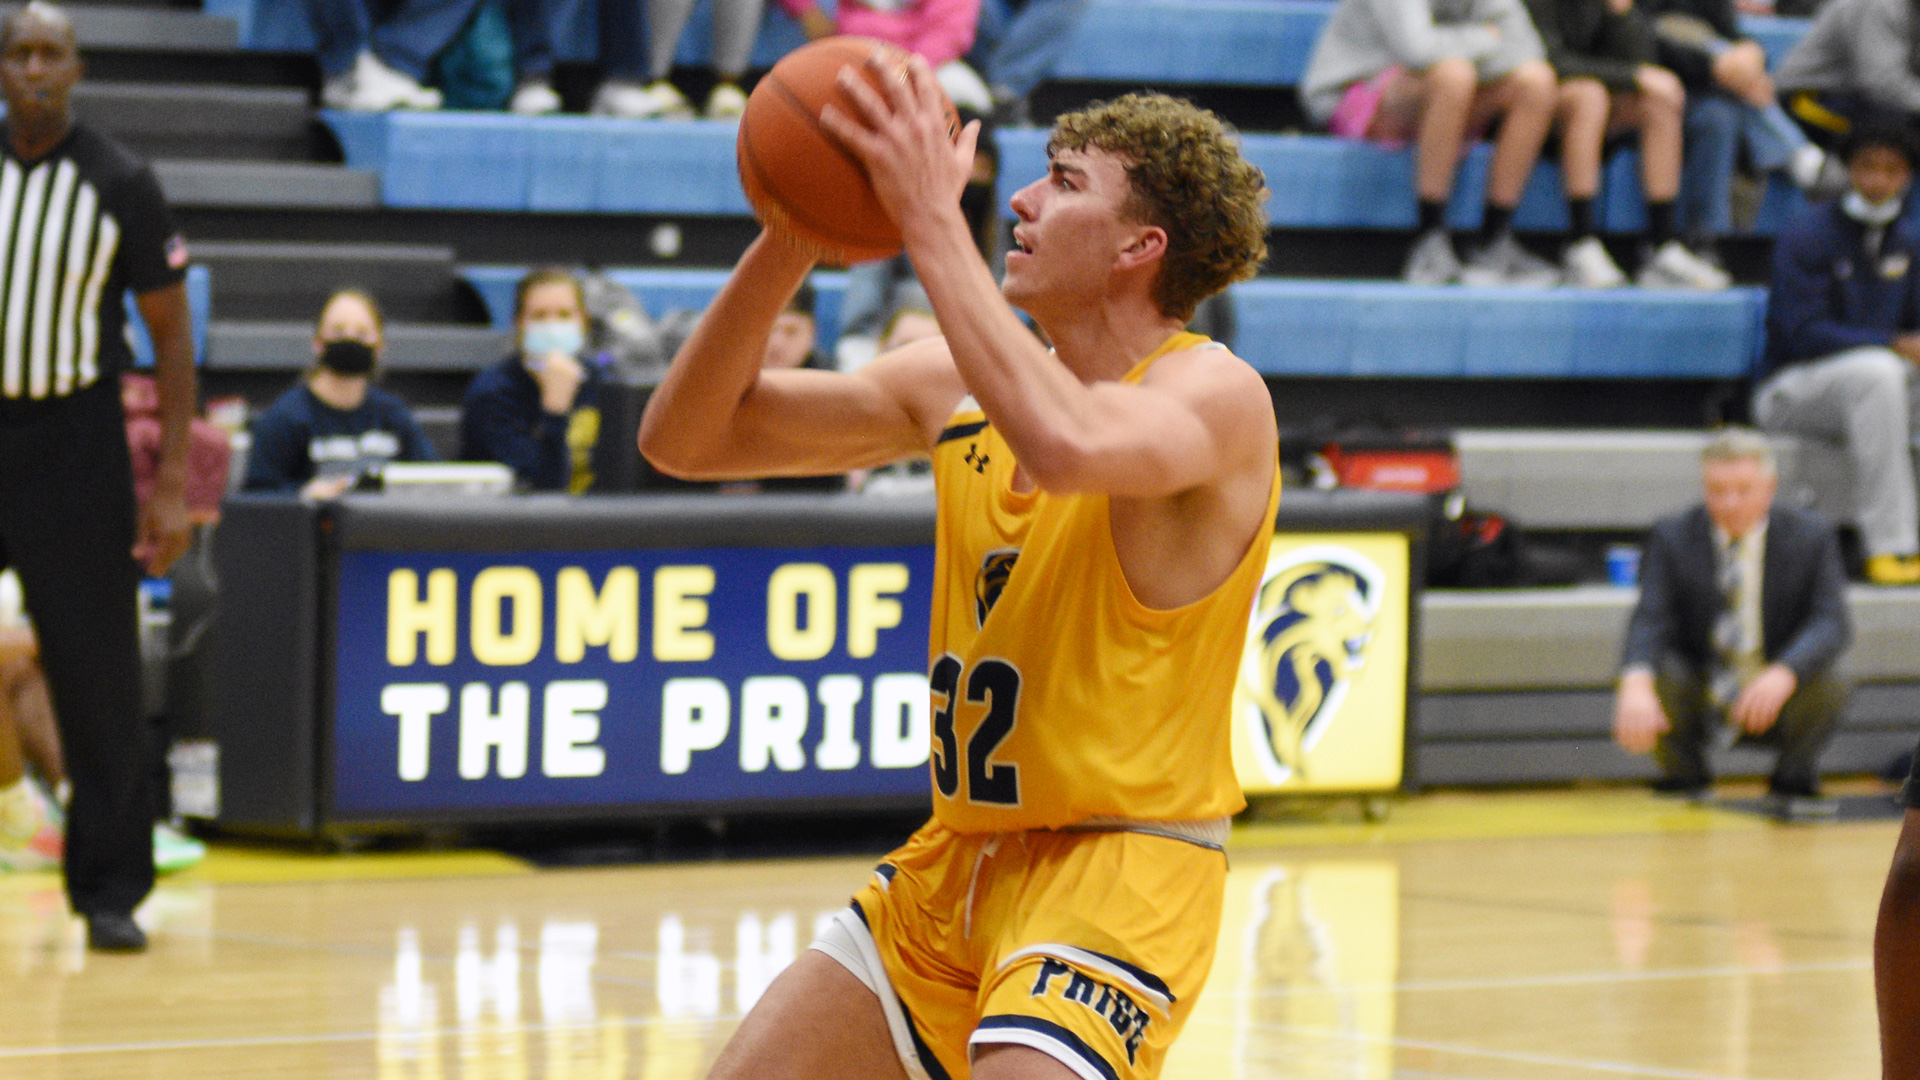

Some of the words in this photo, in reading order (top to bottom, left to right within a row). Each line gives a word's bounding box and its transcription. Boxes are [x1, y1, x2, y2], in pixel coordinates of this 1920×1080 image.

[386, 565, 716, 666] HOME
[766, 562, 909, 661] OF
[380, 679, 608, 781] THE
[930, 651, 1022, 808] 32
